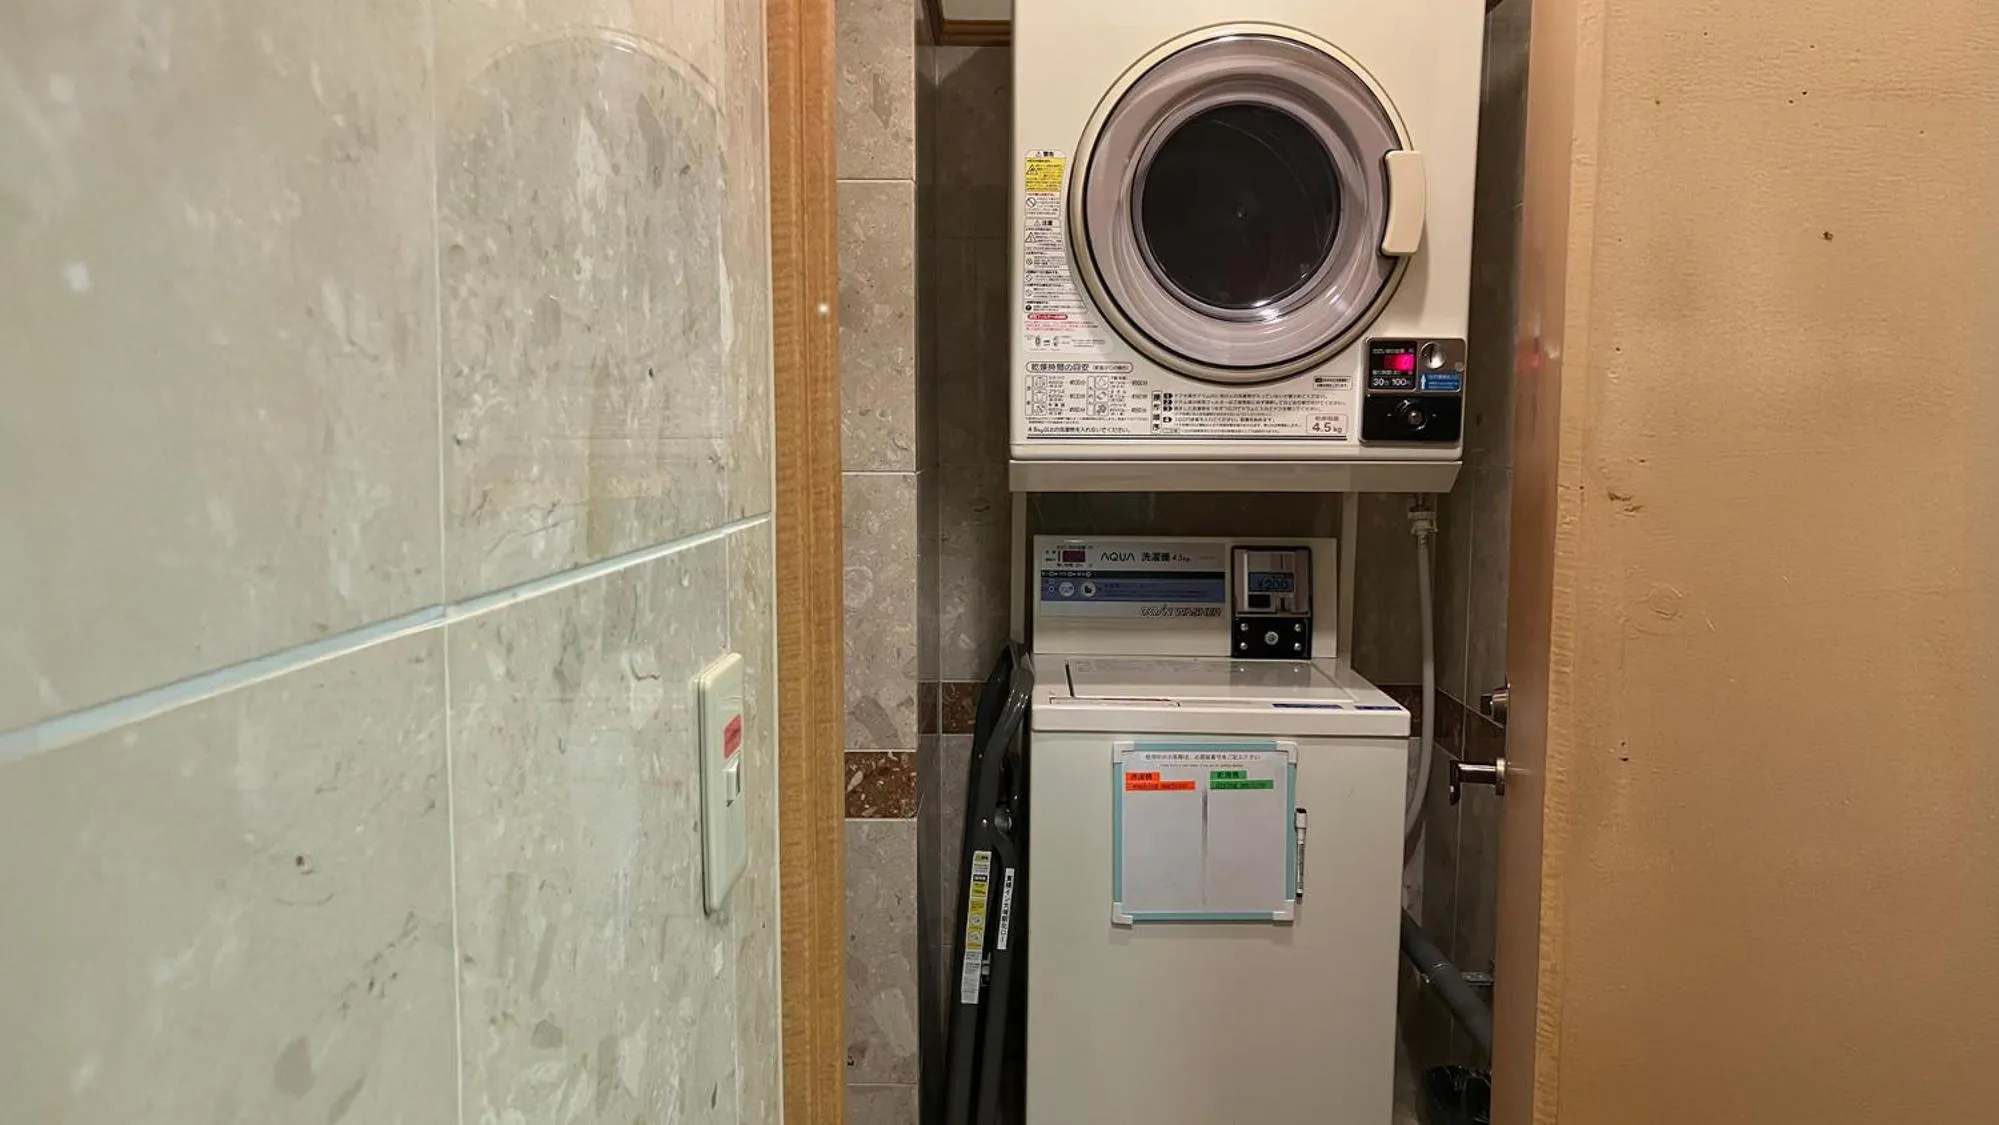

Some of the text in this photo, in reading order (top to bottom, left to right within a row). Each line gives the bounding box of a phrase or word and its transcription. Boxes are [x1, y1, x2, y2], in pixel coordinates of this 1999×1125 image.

[1101, 552, 1135, 562] AQUA
[1141, 552, 1170, 562] 洗濯機
